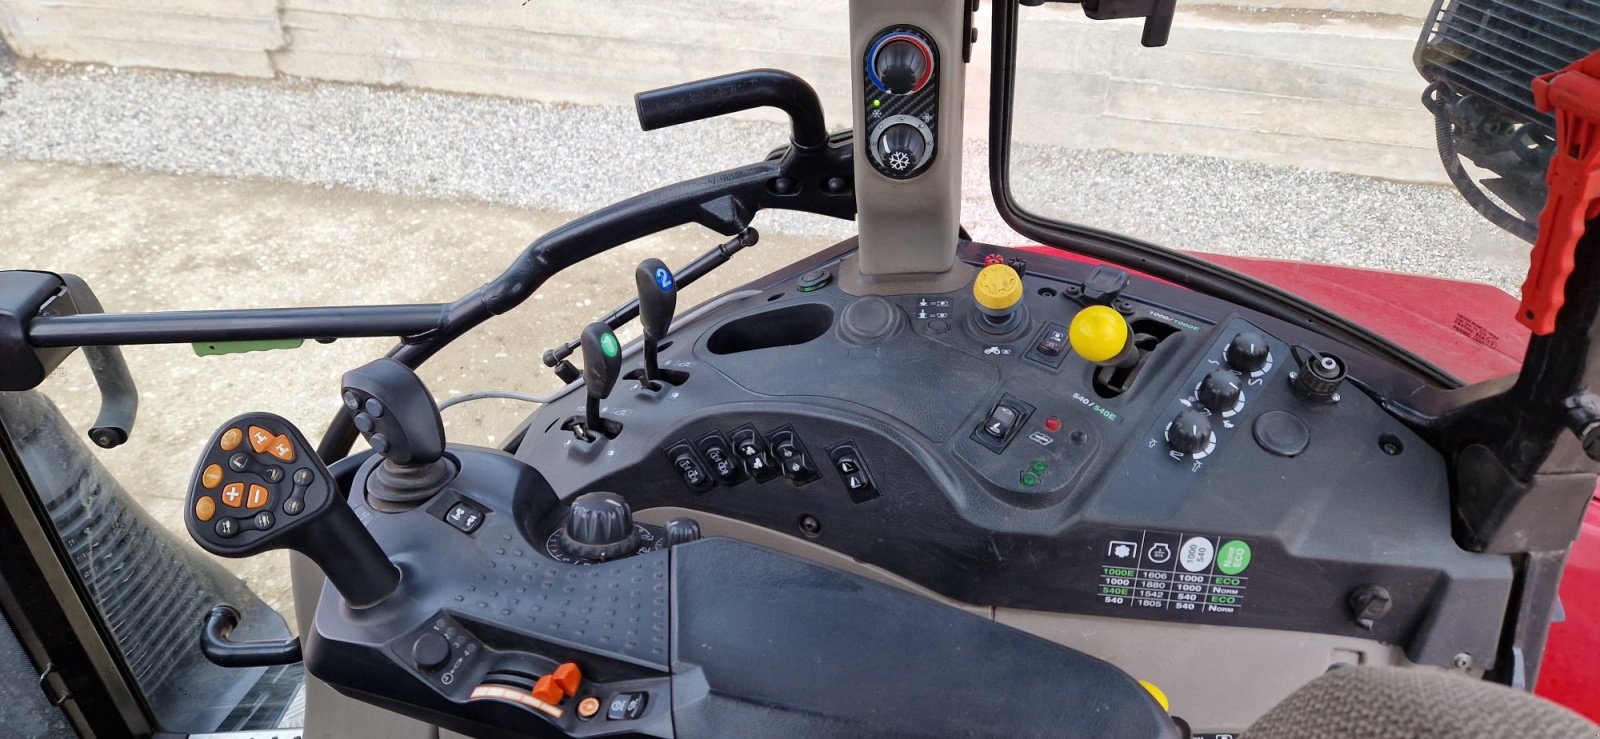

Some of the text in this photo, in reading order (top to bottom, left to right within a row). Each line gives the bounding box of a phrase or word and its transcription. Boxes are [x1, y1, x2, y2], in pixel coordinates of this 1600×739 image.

[655, 268, 672, 288] 2
[601, 335, 616, 353] 1
[1187, 543, 1198, 564] 1000
[1196, 547, 1207, 563] 540
[1232, 548, 1245, 567] ECO
[1103, 568, 1241, 585] 1000E 1606 1000 ECO
[1105, 577, 1130, 586] 1000
[1141, 580, 1166, 589] 1880
[1177, 584, 1202, 592] 1000
[1102, 587, 1236, 604] 540E 1542 540 ECO
[1104, 596, 1124, 604] 540
[1138, 599, 1162, 608] 1805
[1175, 602, 1195, 611] 540
